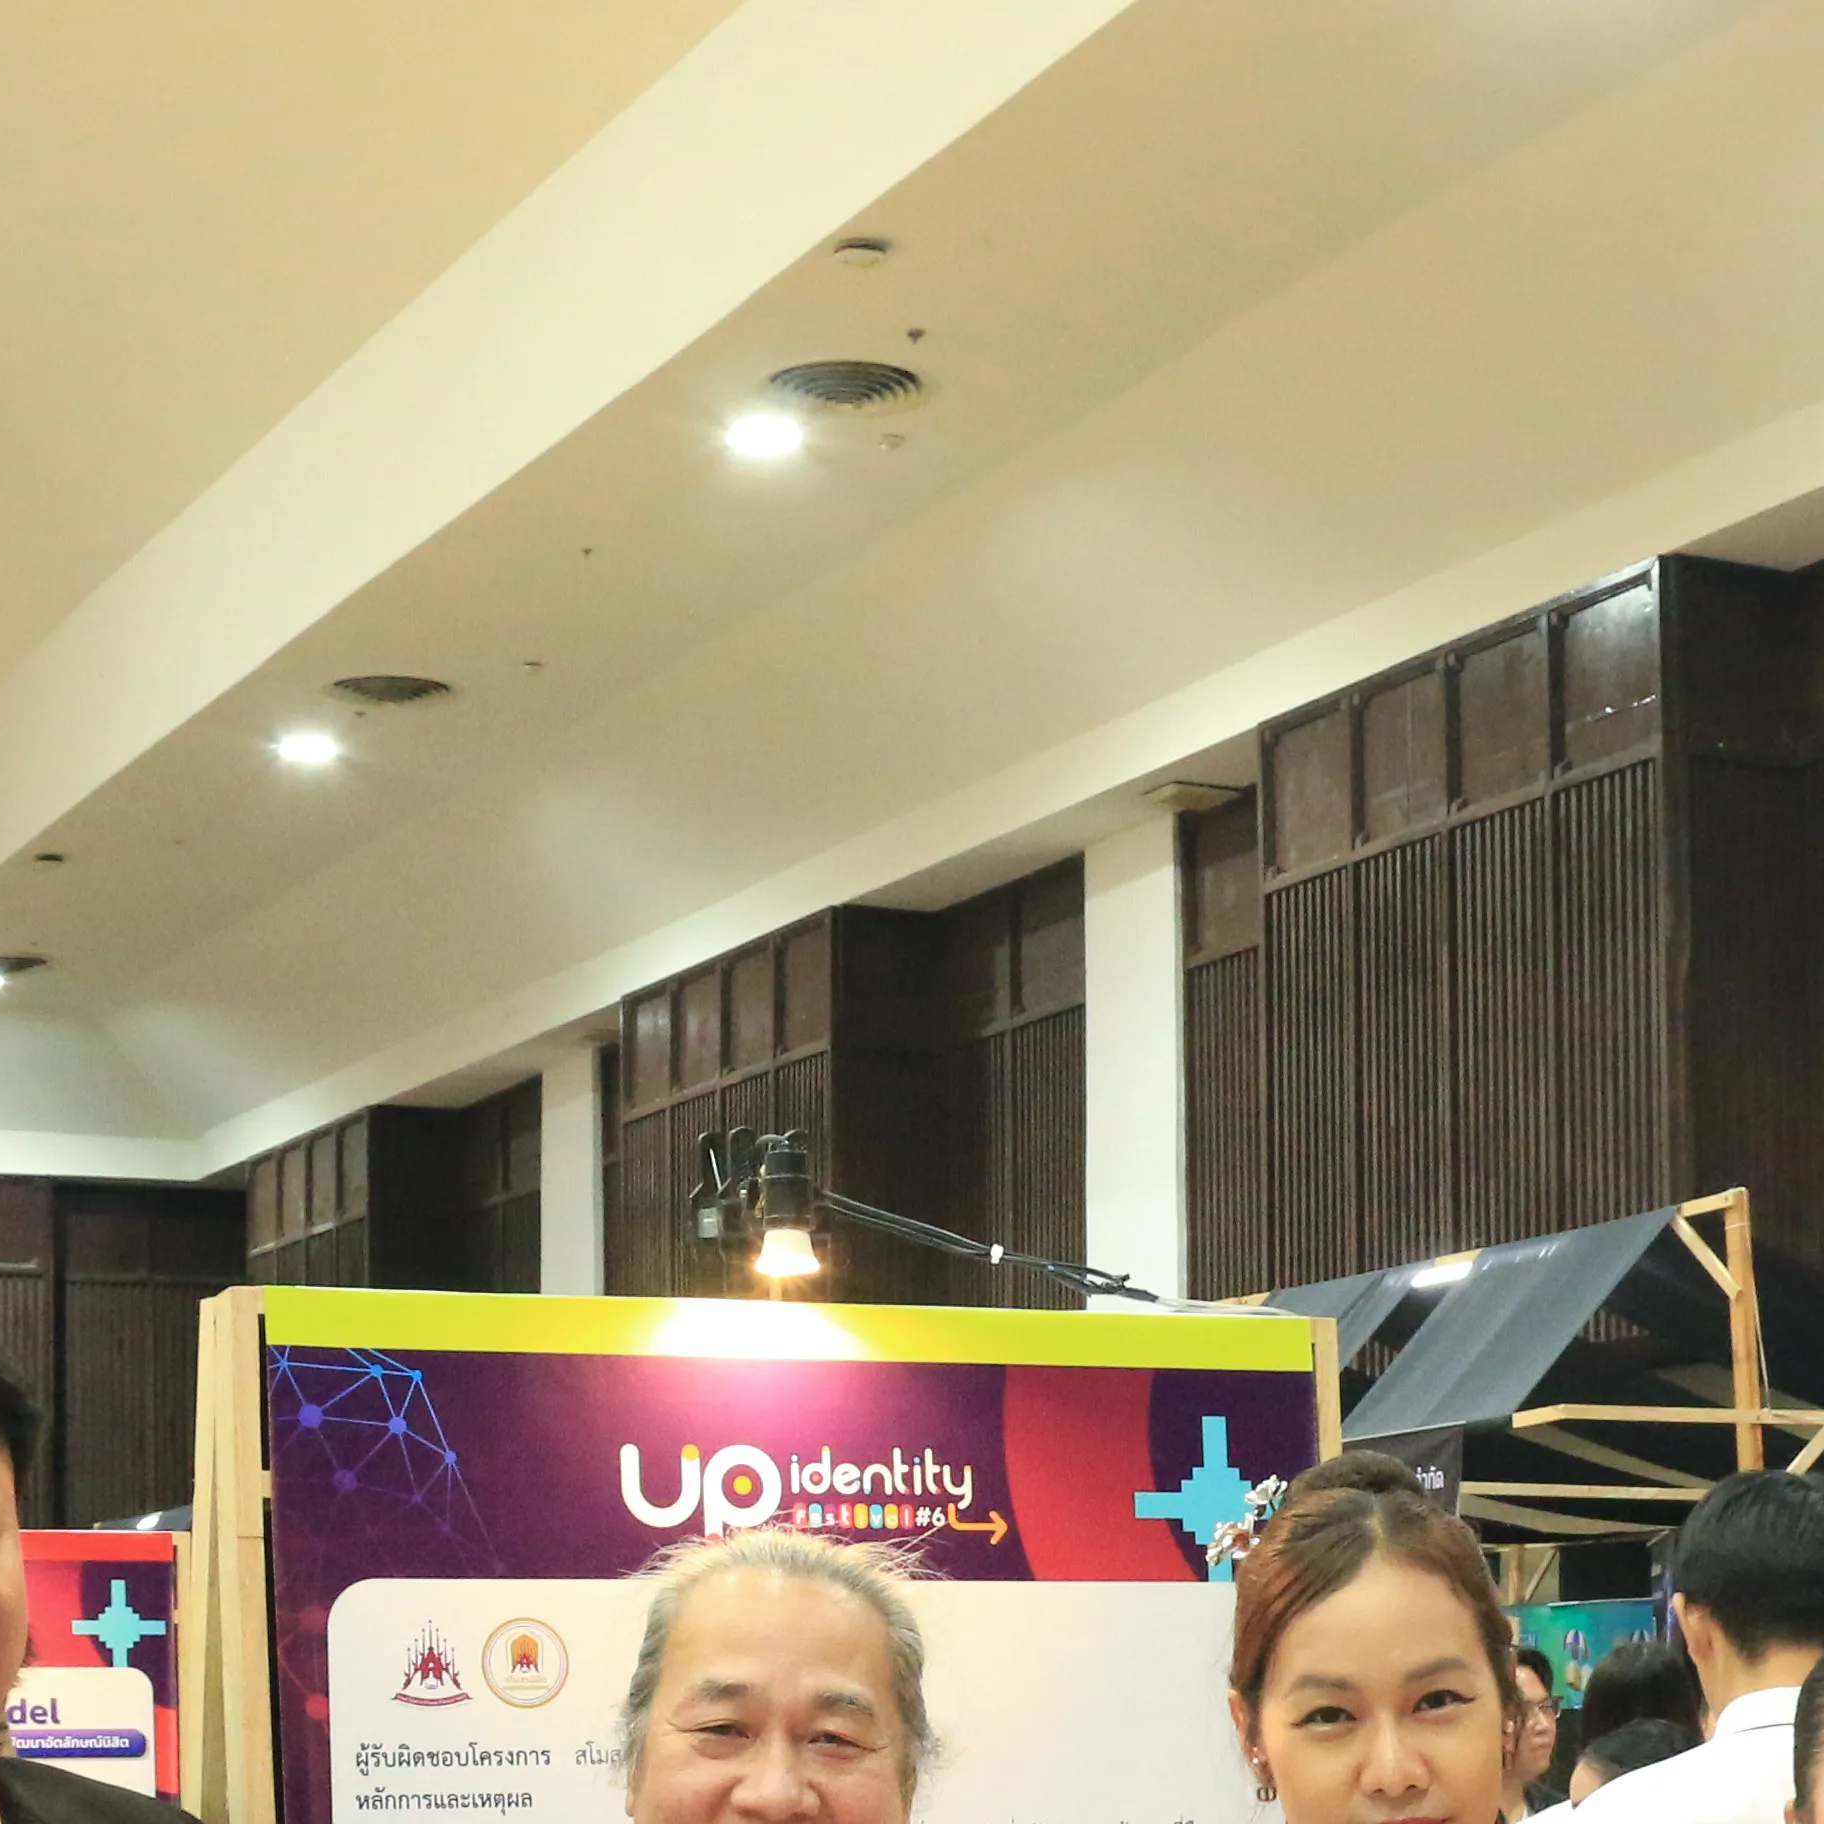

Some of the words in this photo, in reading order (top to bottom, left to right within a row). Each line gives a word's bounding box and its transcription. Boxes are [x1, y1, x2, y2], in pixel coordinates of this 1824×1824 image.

[790, 1445, 973, 1510] identity
[355, 1742, 551, 1777] ผู้รับผิดชอบโครงการ
[355, 1787, 533, 1815] หลักการและเหตุผล
